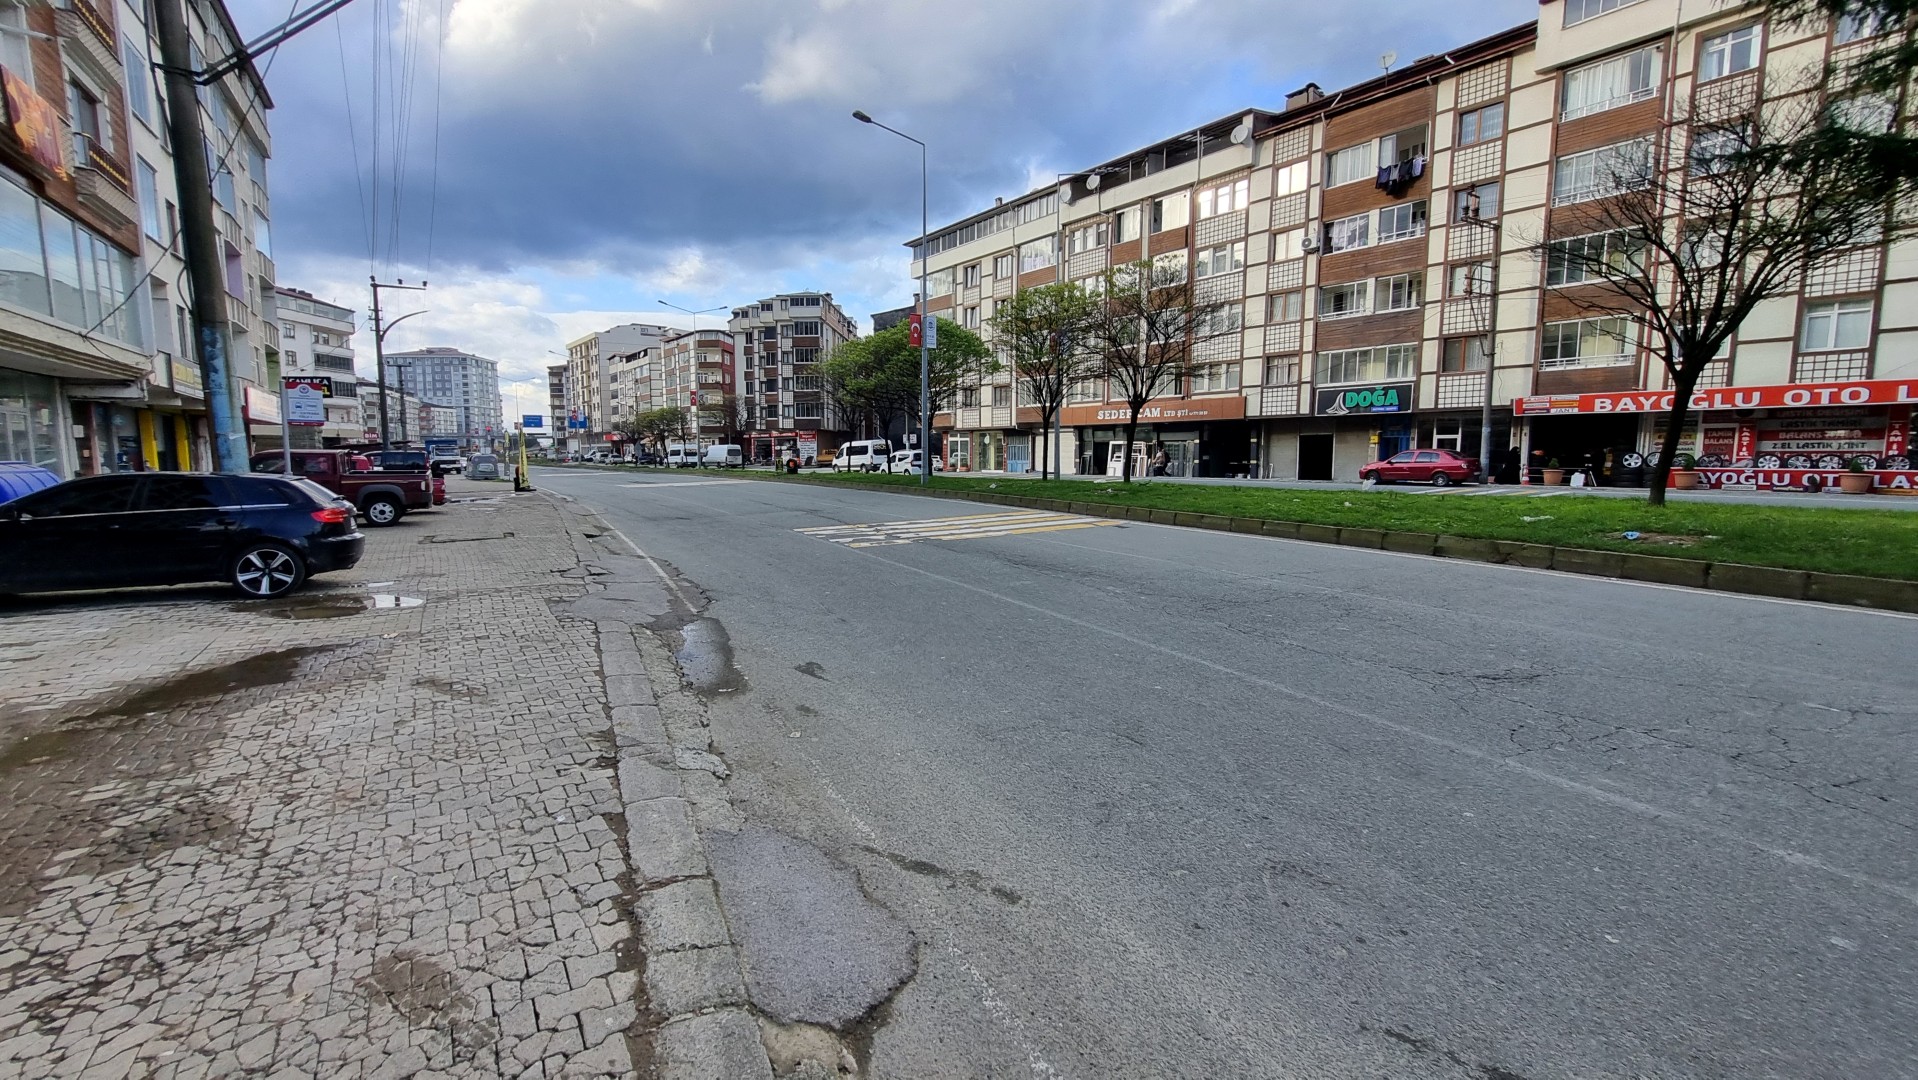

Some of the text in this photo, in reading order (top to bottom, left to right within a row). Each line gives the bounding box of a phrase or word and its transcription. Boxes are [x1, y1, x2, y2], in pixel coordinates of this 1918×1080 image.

[1345, 385, 1399, 407] DOĞA
[1783, 386, 1870, 406] OTO
[1796, 442, 1833, 450] LASTİK
